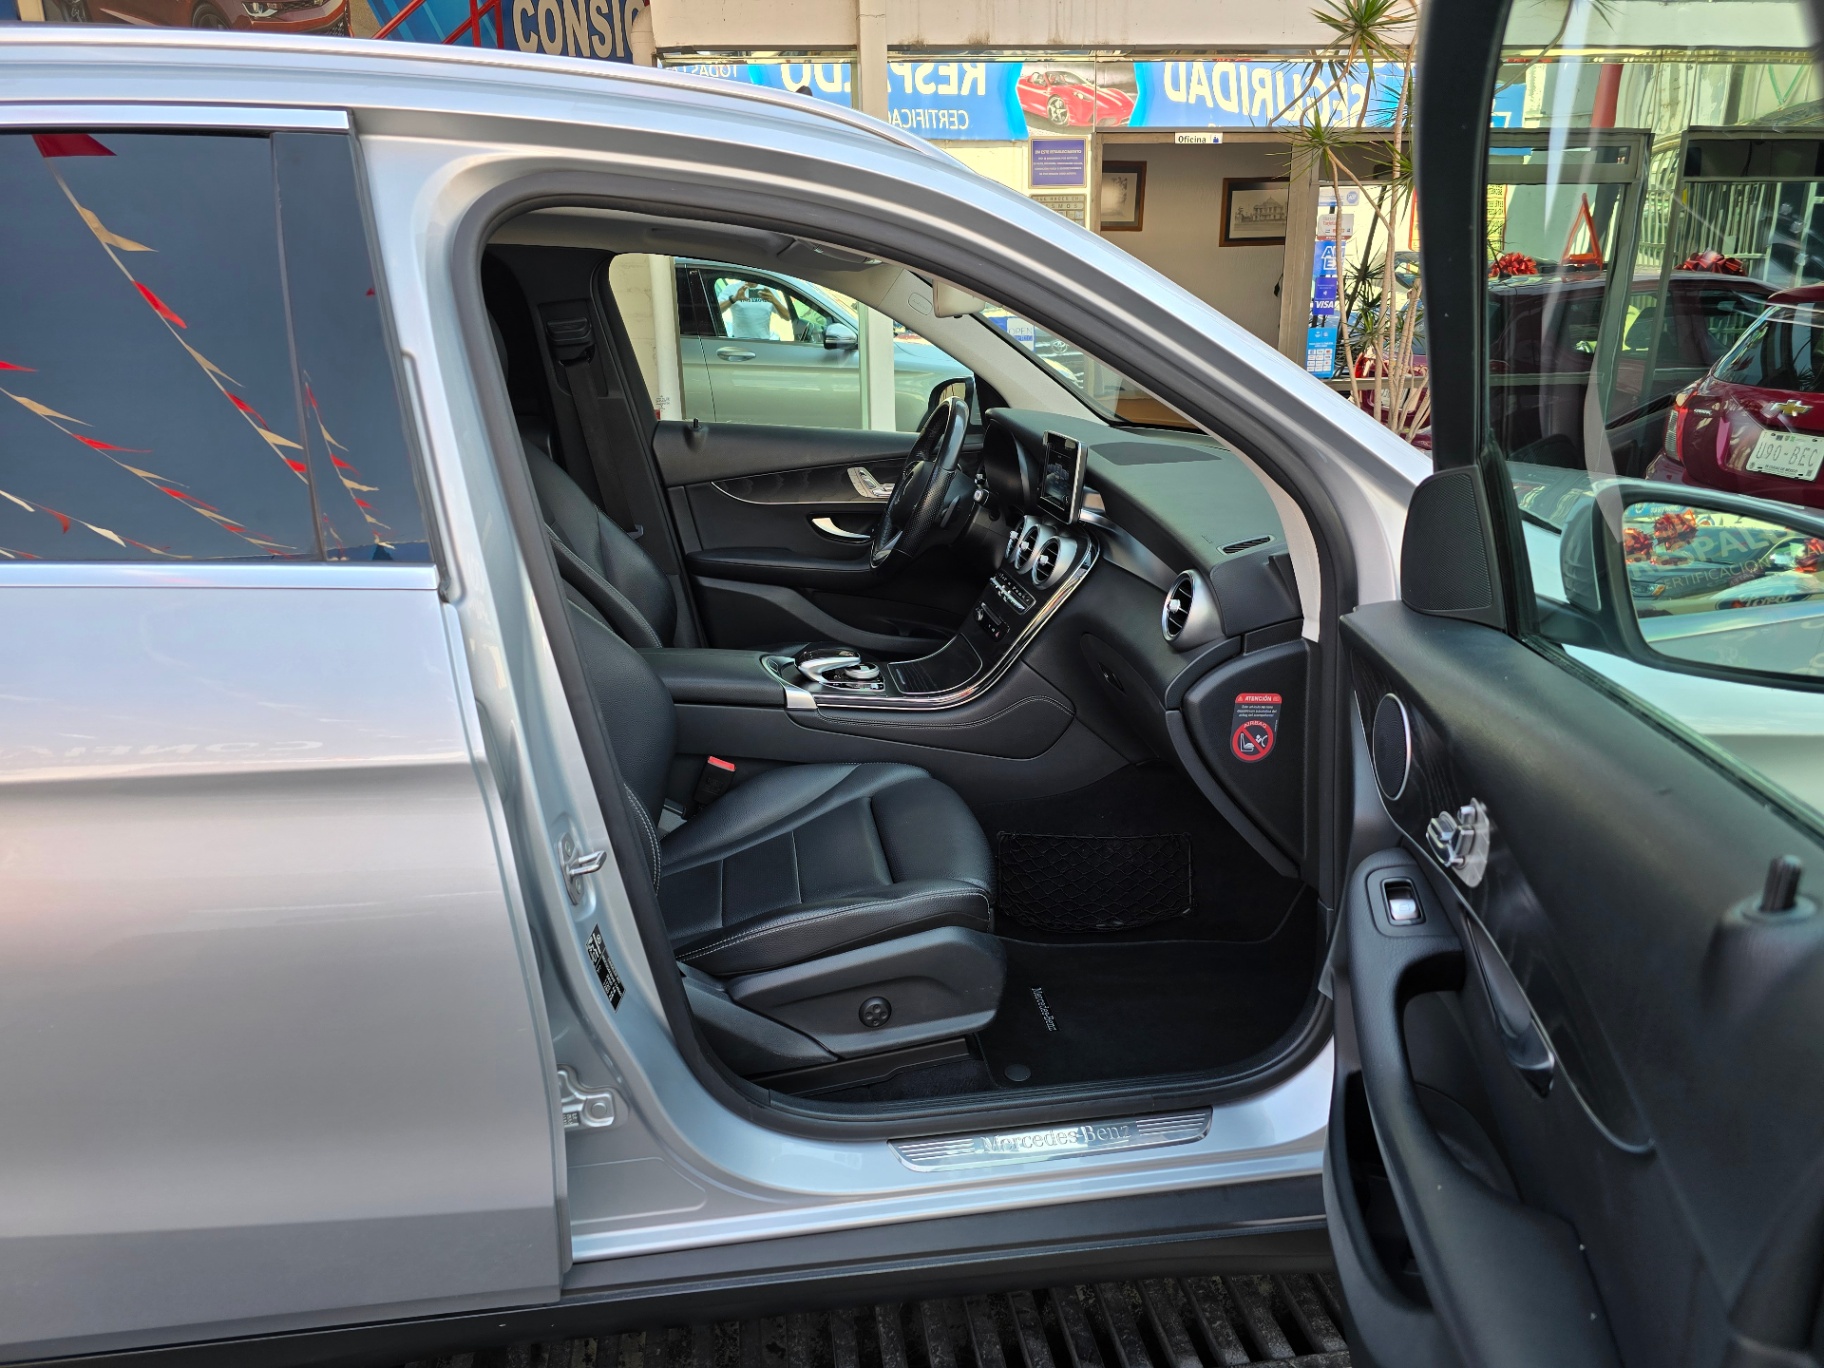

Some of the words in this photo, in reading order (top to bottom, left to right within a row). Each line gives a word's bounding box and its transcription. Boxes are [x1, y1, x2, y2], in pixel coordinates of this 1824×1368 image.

[1177, 135, 1207, 144] Oficina
[1315, 300, 1334, 309] VISA
[1755, 441, 1818, 467] U90-BEC
[981, 1124, 1131, 1152] Mercedes-Benz
